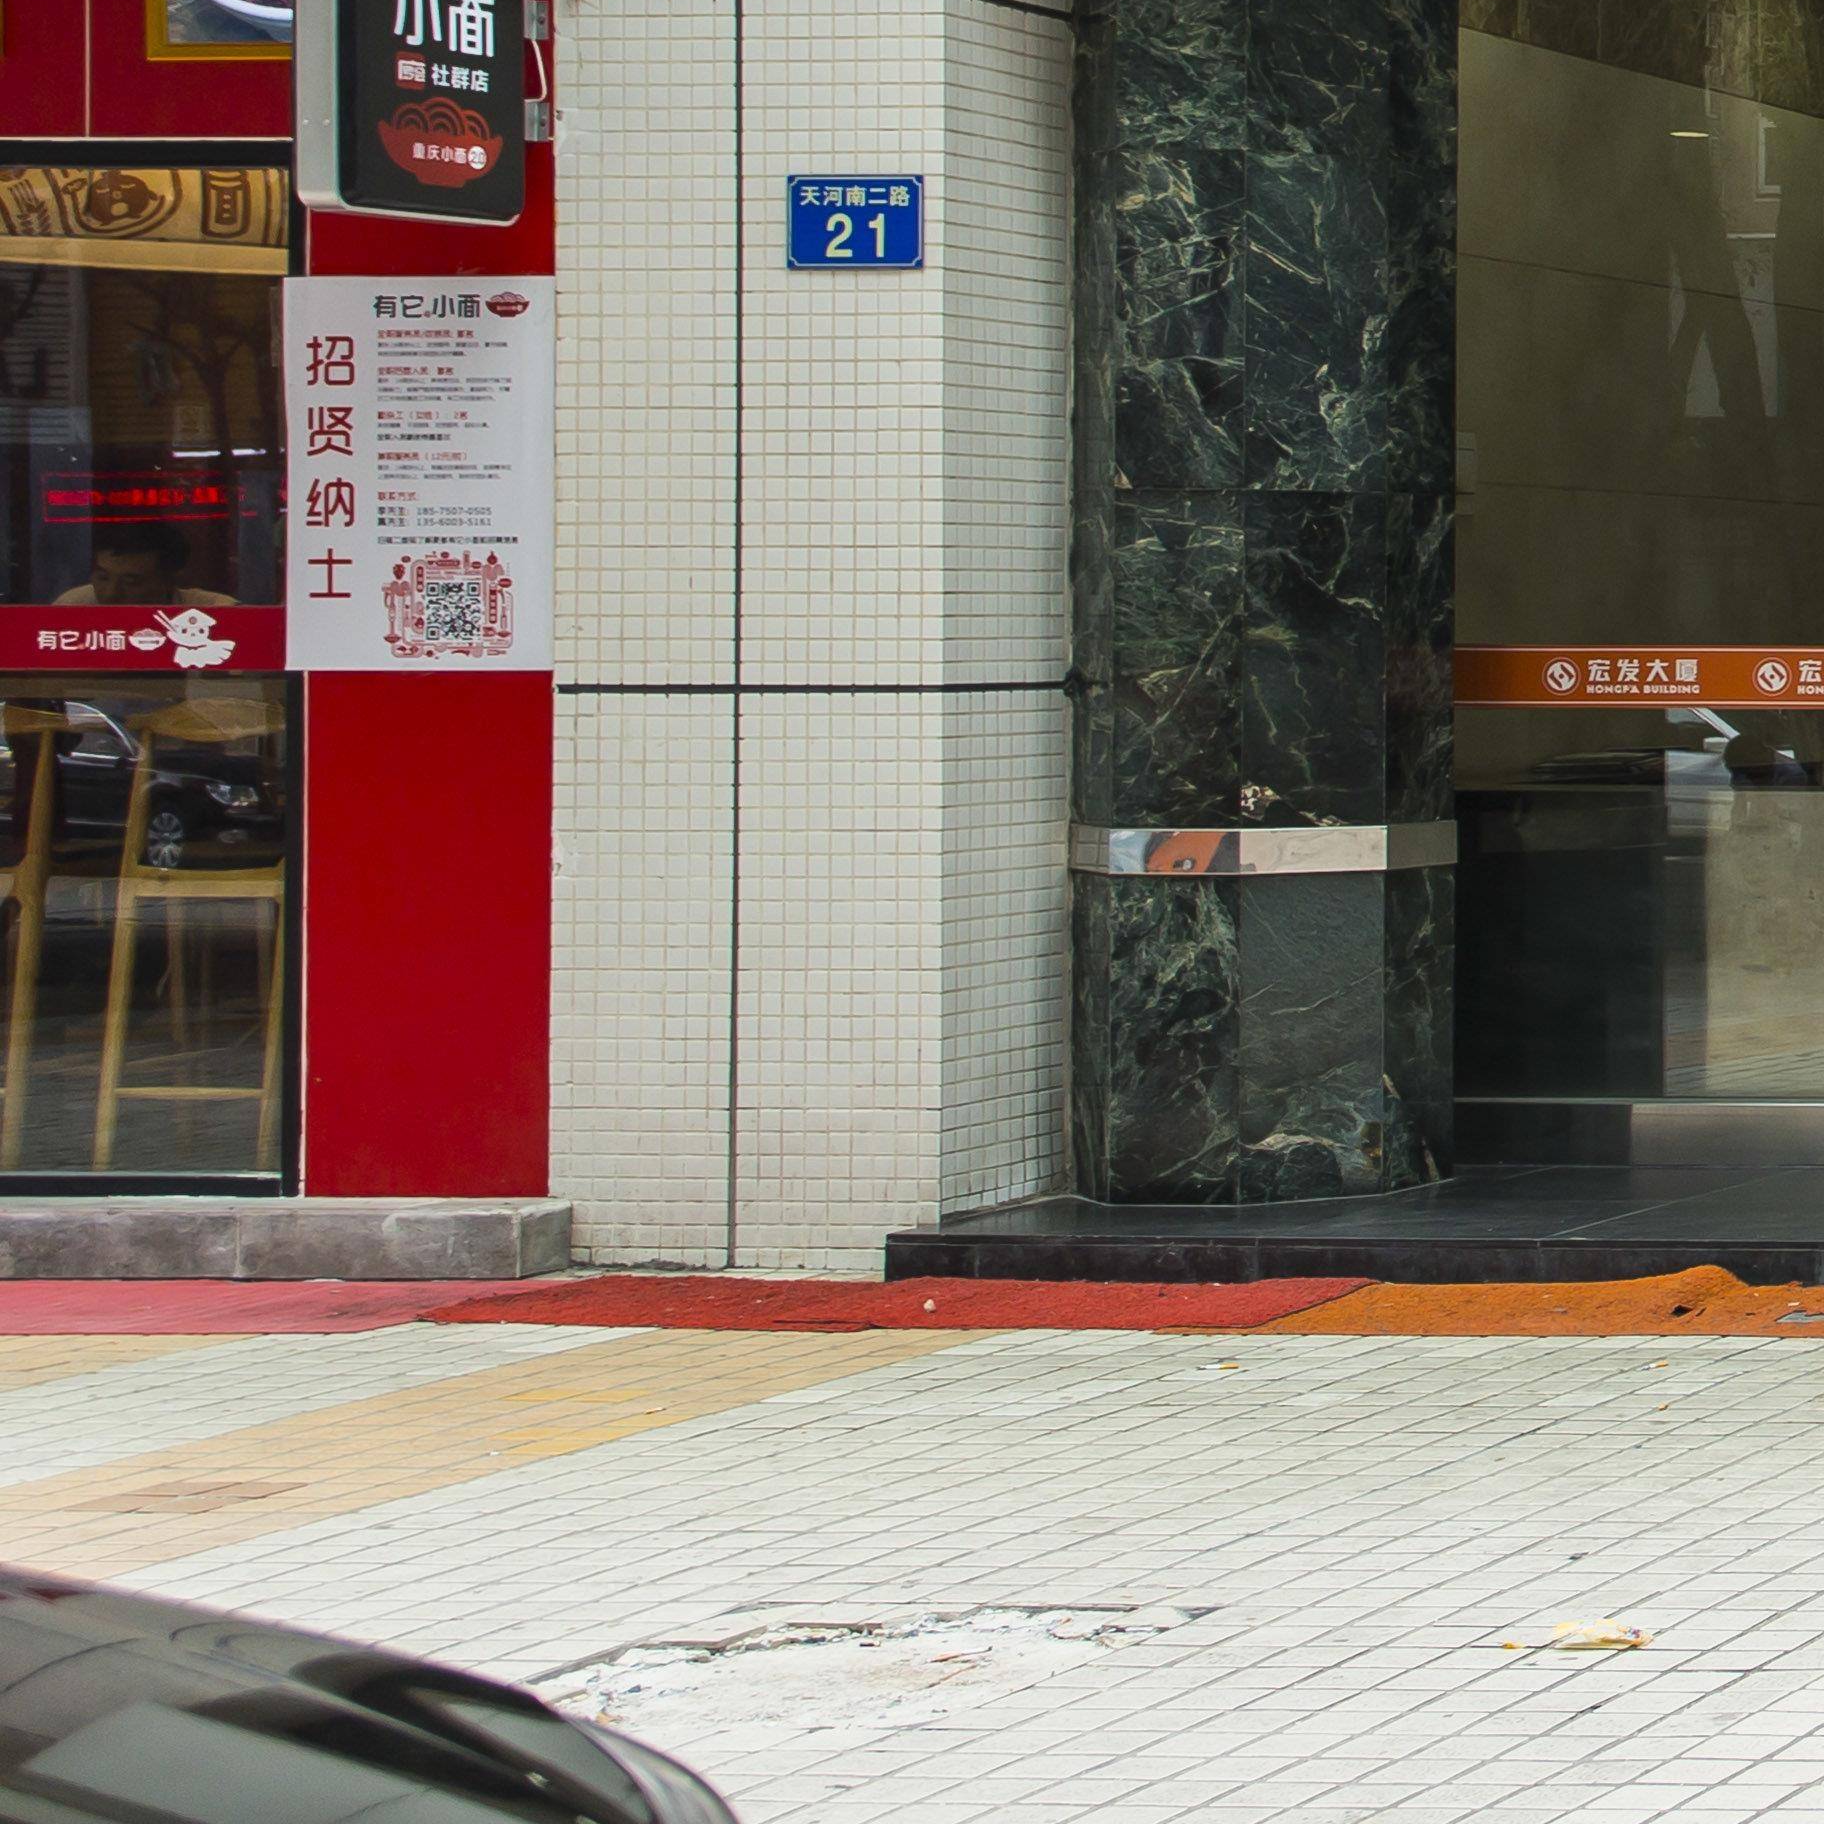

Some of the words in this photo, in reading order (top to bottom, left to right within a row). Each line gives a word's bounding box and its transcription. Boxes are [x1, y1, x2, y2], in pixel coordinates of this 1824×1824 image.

[430, 63, 490, 94] 社群店
[799, 185, 910, 207] 天河南二路
[825, 212, 885, 258] 21
[305, 335, 355, 599] 招贤纳士
[37, 630, 127, 651] 有它小面
[1587, 658, 1700, 683] 宏发大厦
[1642, 684, 1700, 695] BUILDING
